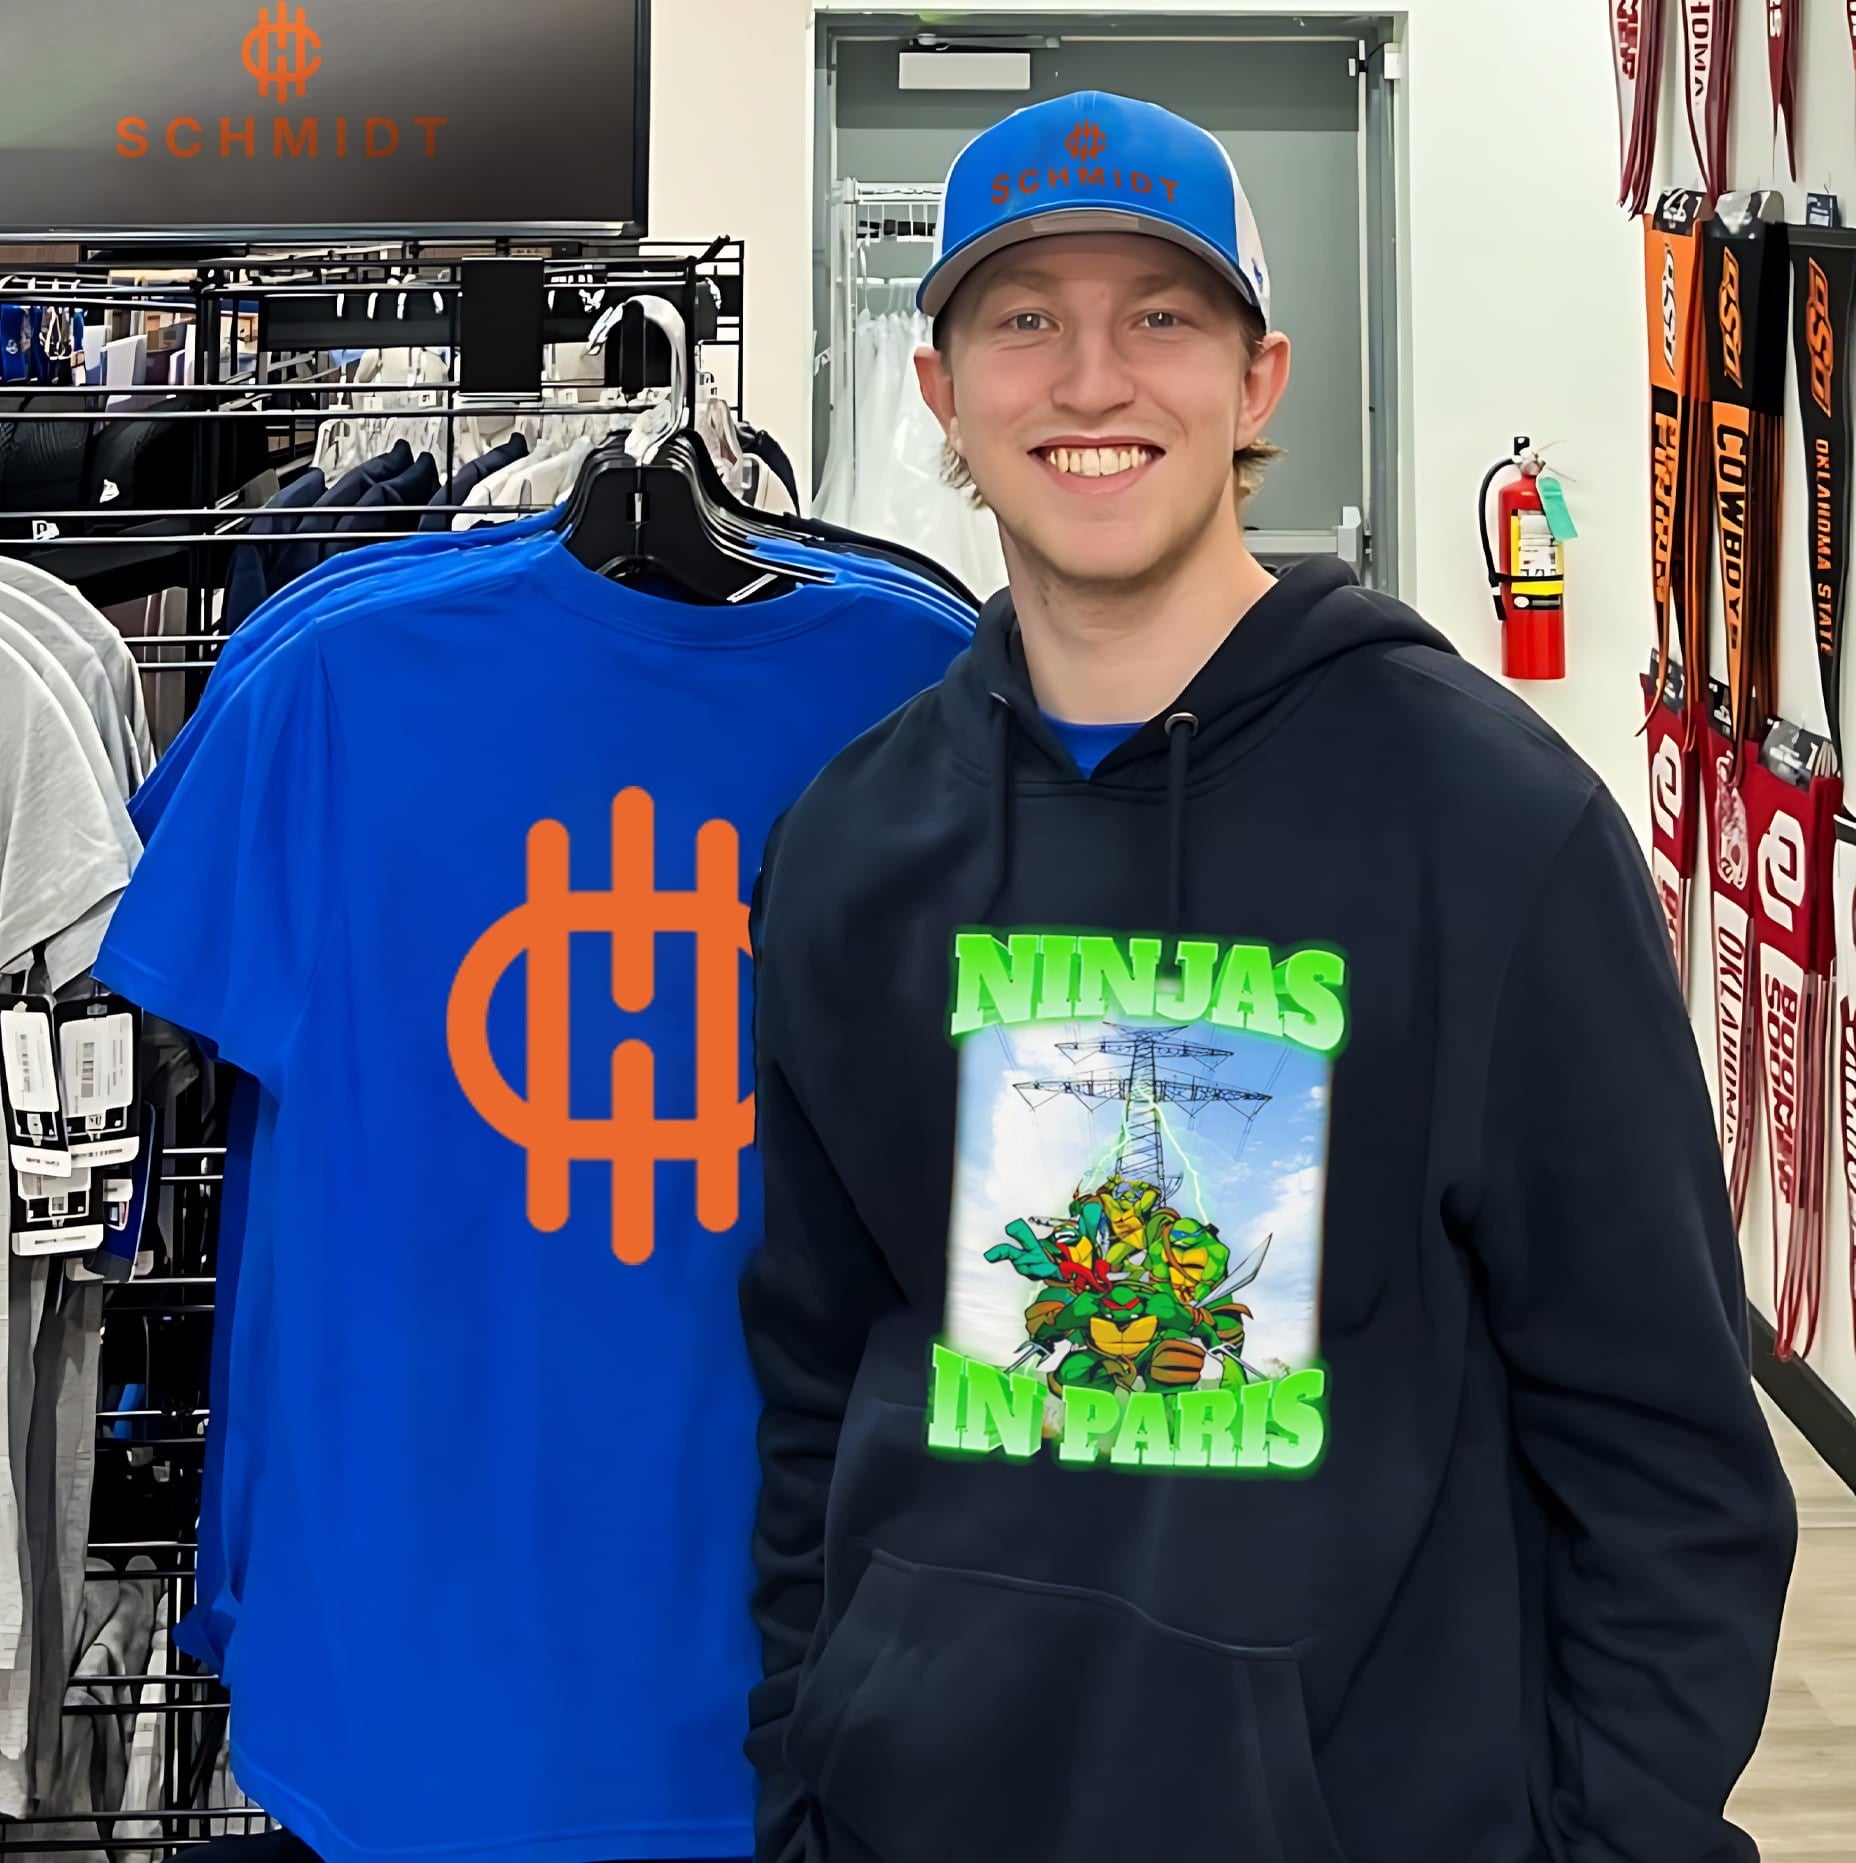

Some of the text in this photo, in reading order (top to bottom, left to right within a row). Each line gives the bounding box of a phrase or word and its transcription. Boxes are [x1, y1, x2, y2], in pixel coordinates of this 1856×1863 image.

[115, 116, 447, 159] SCHMIDT
[991, 166, 1179, 205] SCHMIDT
[1815, 438, 1832, 570] OKLAHOMA
[950, 933, 1345, 1051] NINJAS
[1718, 926, 1745, 1144] OKLAHOMA
[927, 1343, 1326, 1469] IN PARIS
